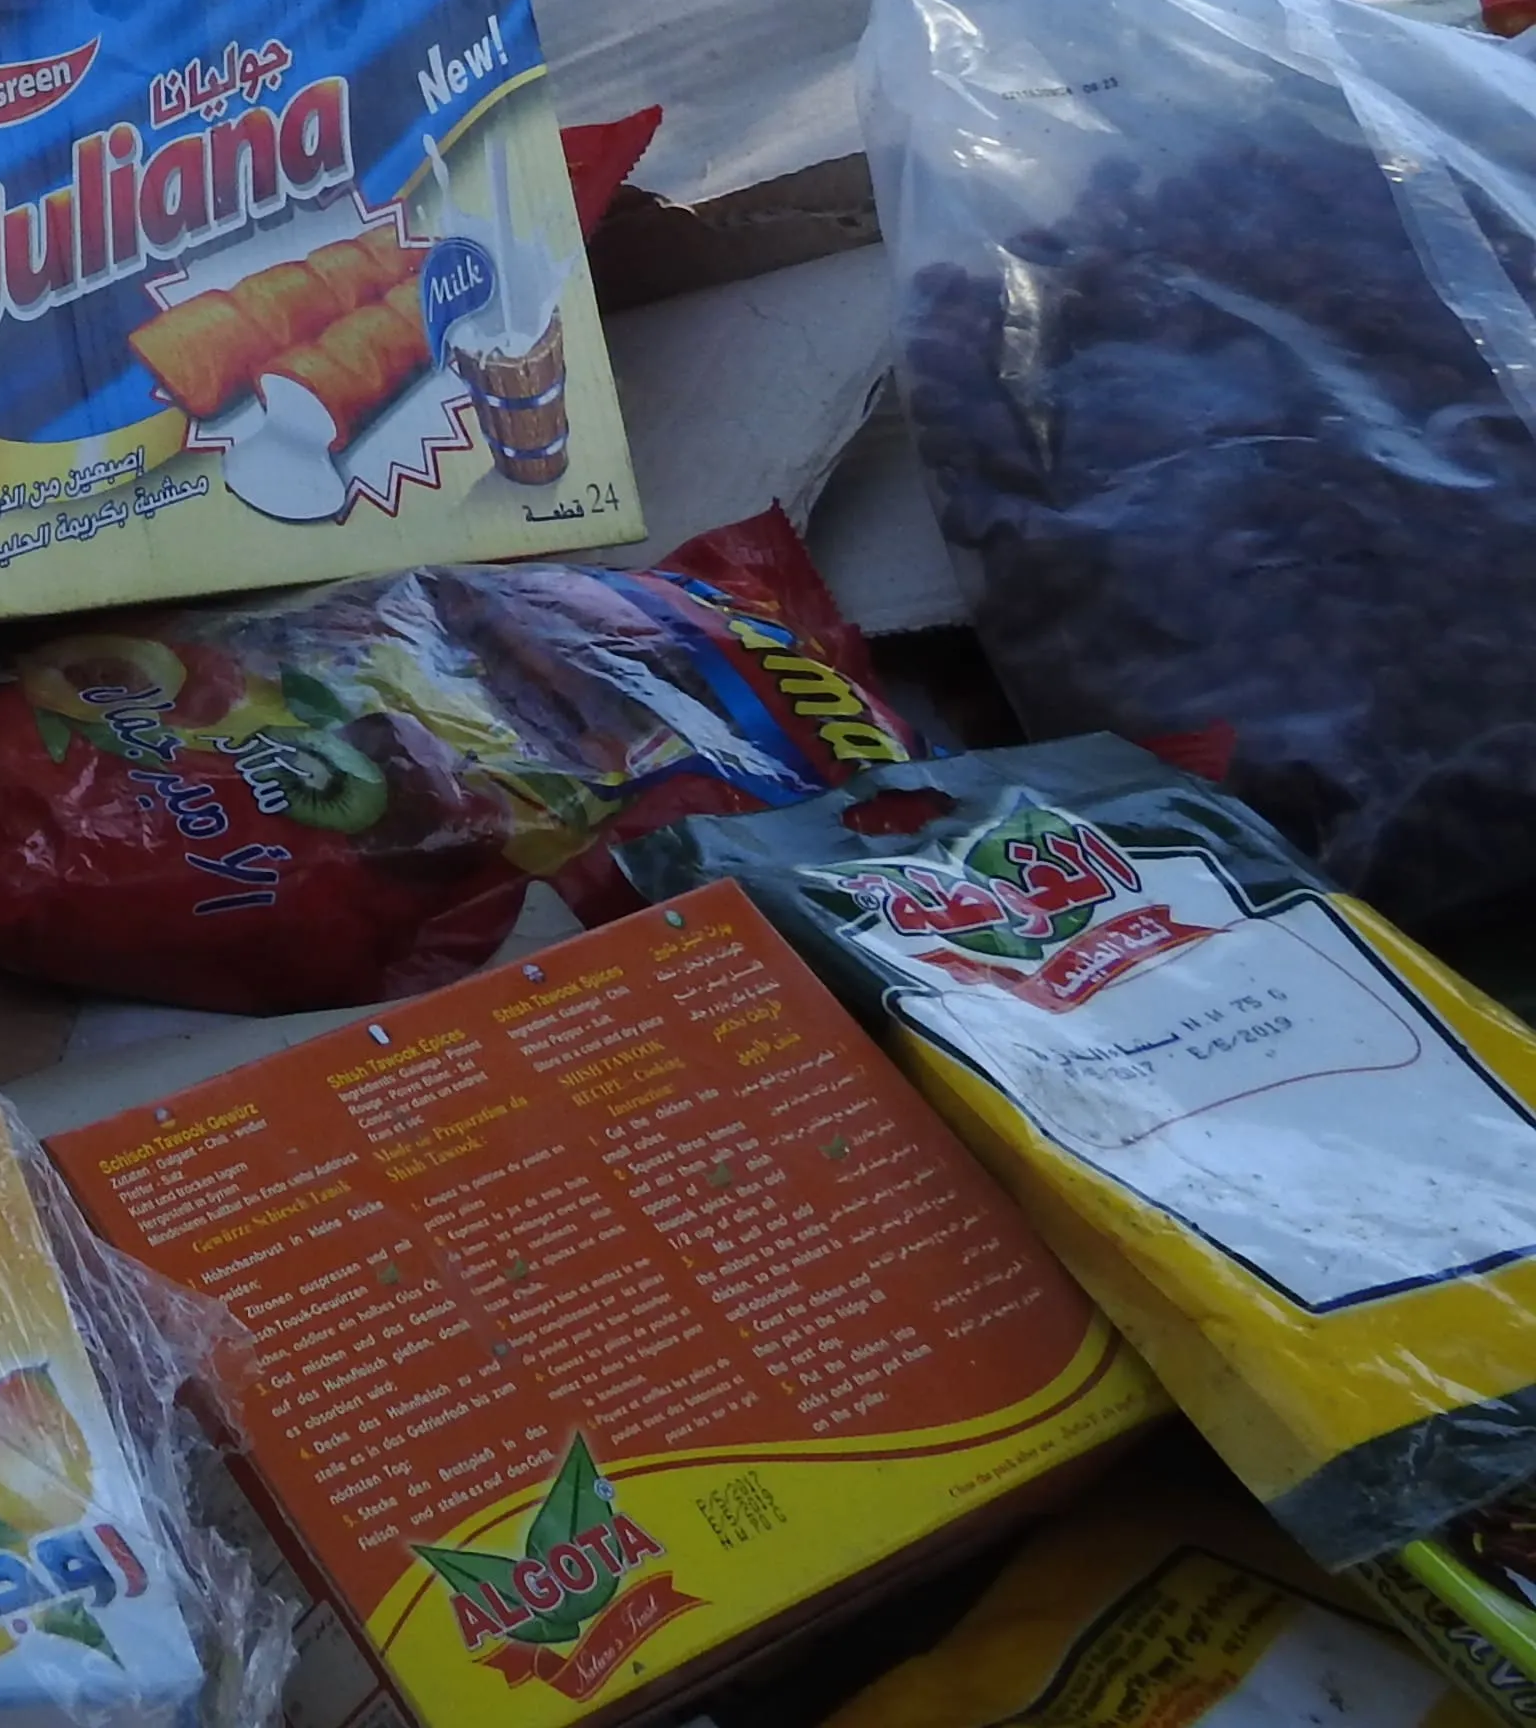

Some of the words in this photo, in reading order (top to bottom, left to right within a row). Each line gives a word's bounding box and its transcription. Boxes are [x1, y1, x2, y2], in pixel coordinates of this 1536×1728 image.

[149, 39, 291, 128] جوليانا
[417, 14, 509, 114] New!
[427, 262, 486, 306] Milk
[28, 469, 61, 506] من
[133, 474, 210, 521] محشية
[525, 498, 584, 525] قطعة
[588, 485, 621, 514] 24
[55, 495, 128, 544] بكريمة
[837, 825, 1141, 936] الغوطة
[492, 1000, 527, 1026] Shish
[523, 978, 582, 1014] Tawook
[579, 961, 625, 992] Spices
[325, 1062, 366, 1090] Shish
[366, 1042, 420, 1075] Tawook
[97, 1141, 157, 1176] Schisch
[153, 1120, 209, 1153] Tawook
[205, 1100, 259, 1132] Gewürz
[243, 1289, 296, 1321] Zitronen
[269, 1369, 297, 1392] Gut
[300, 1344, 349, 1379] mischen
[351, 1331, 377, 1354] und
[380, 1318, 405, 1340] das
[294, 1384, 321, 1407] das
[356, 1412, 382, 1435] das
[448, 1512, 665, 1650] ALGOTA
